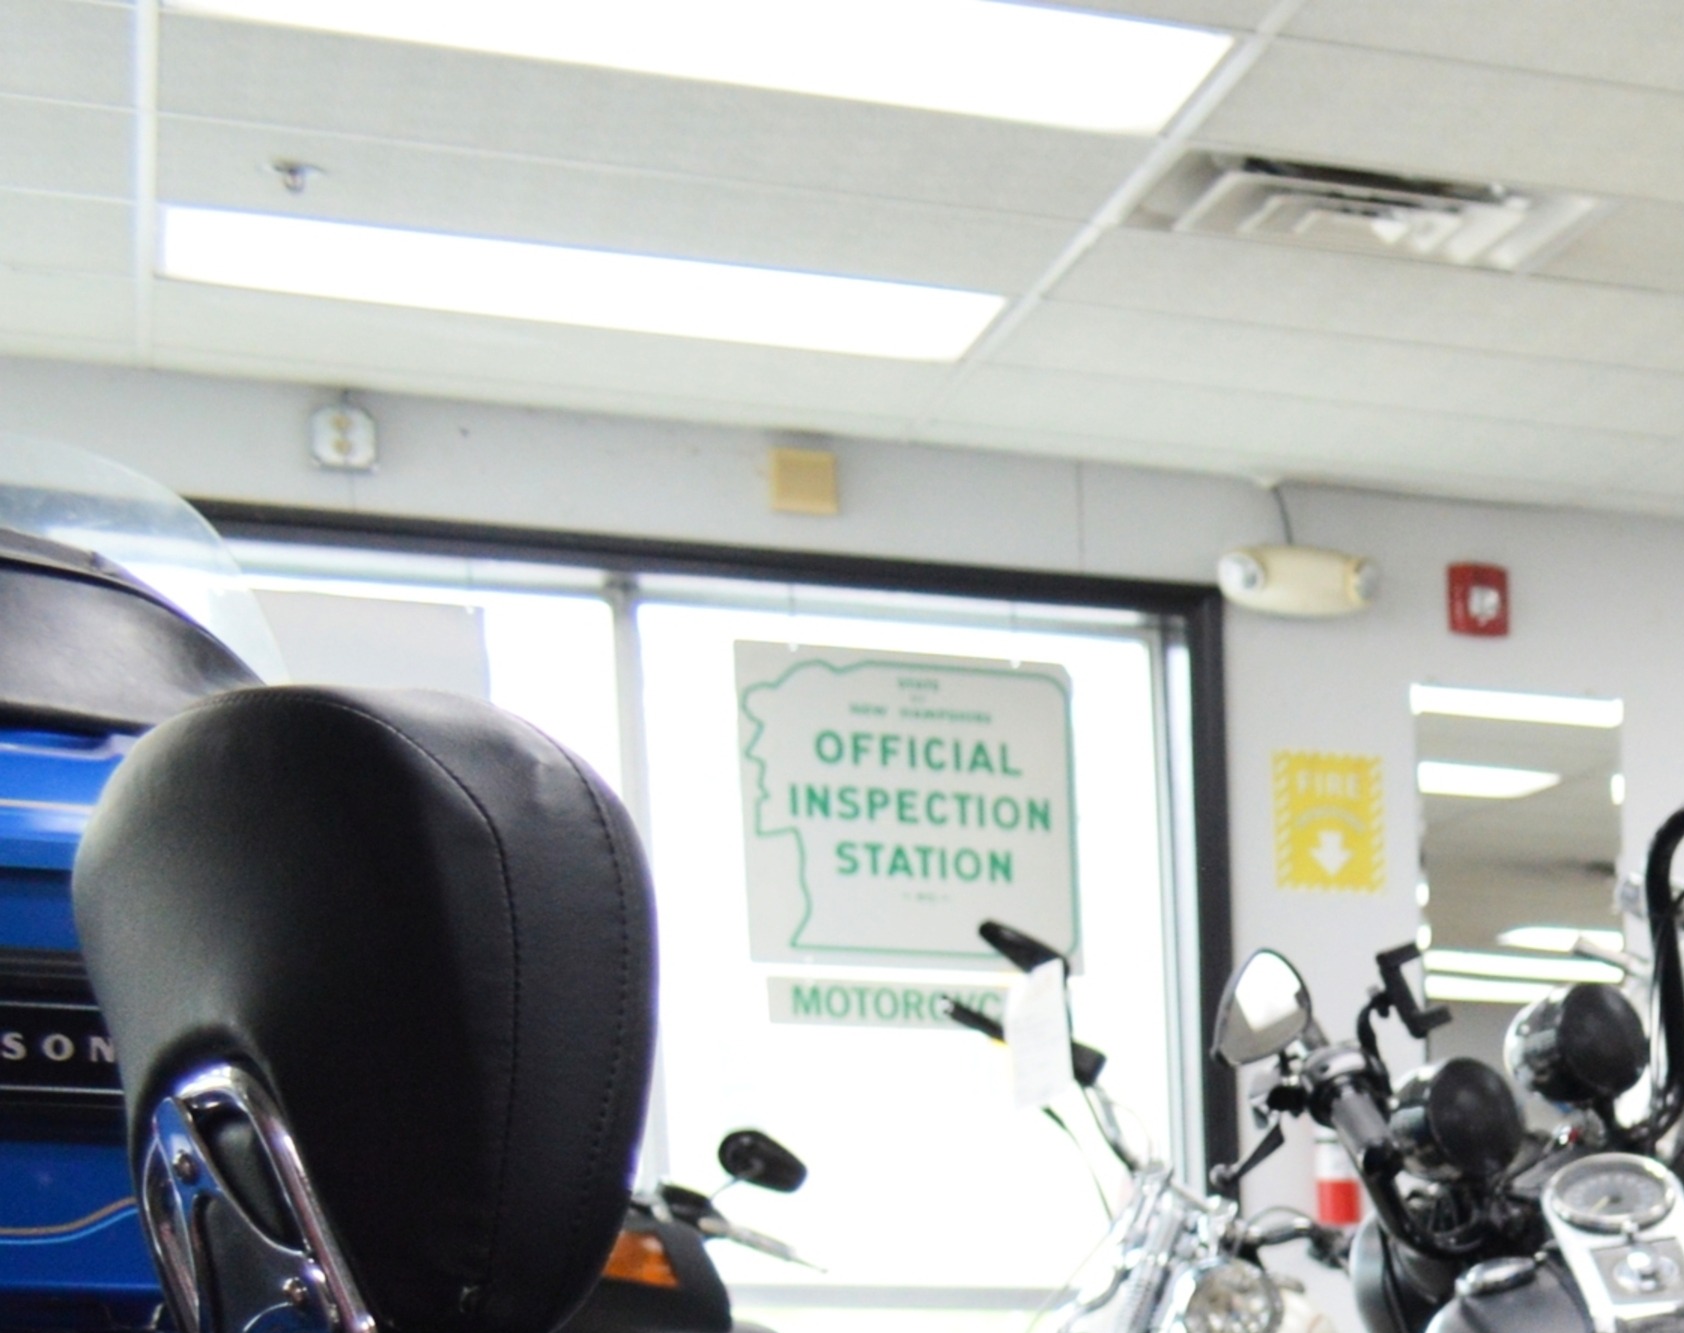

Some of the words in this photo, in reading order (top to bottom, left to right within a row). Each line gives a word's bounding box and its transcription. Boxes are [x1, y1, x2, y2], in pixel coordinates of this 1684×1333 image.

[814, 729, 1023, 778] OFFICIAL
[789, 782, 1052, 832] INSPECTION
[835, 840, 1014, 884] STATION
